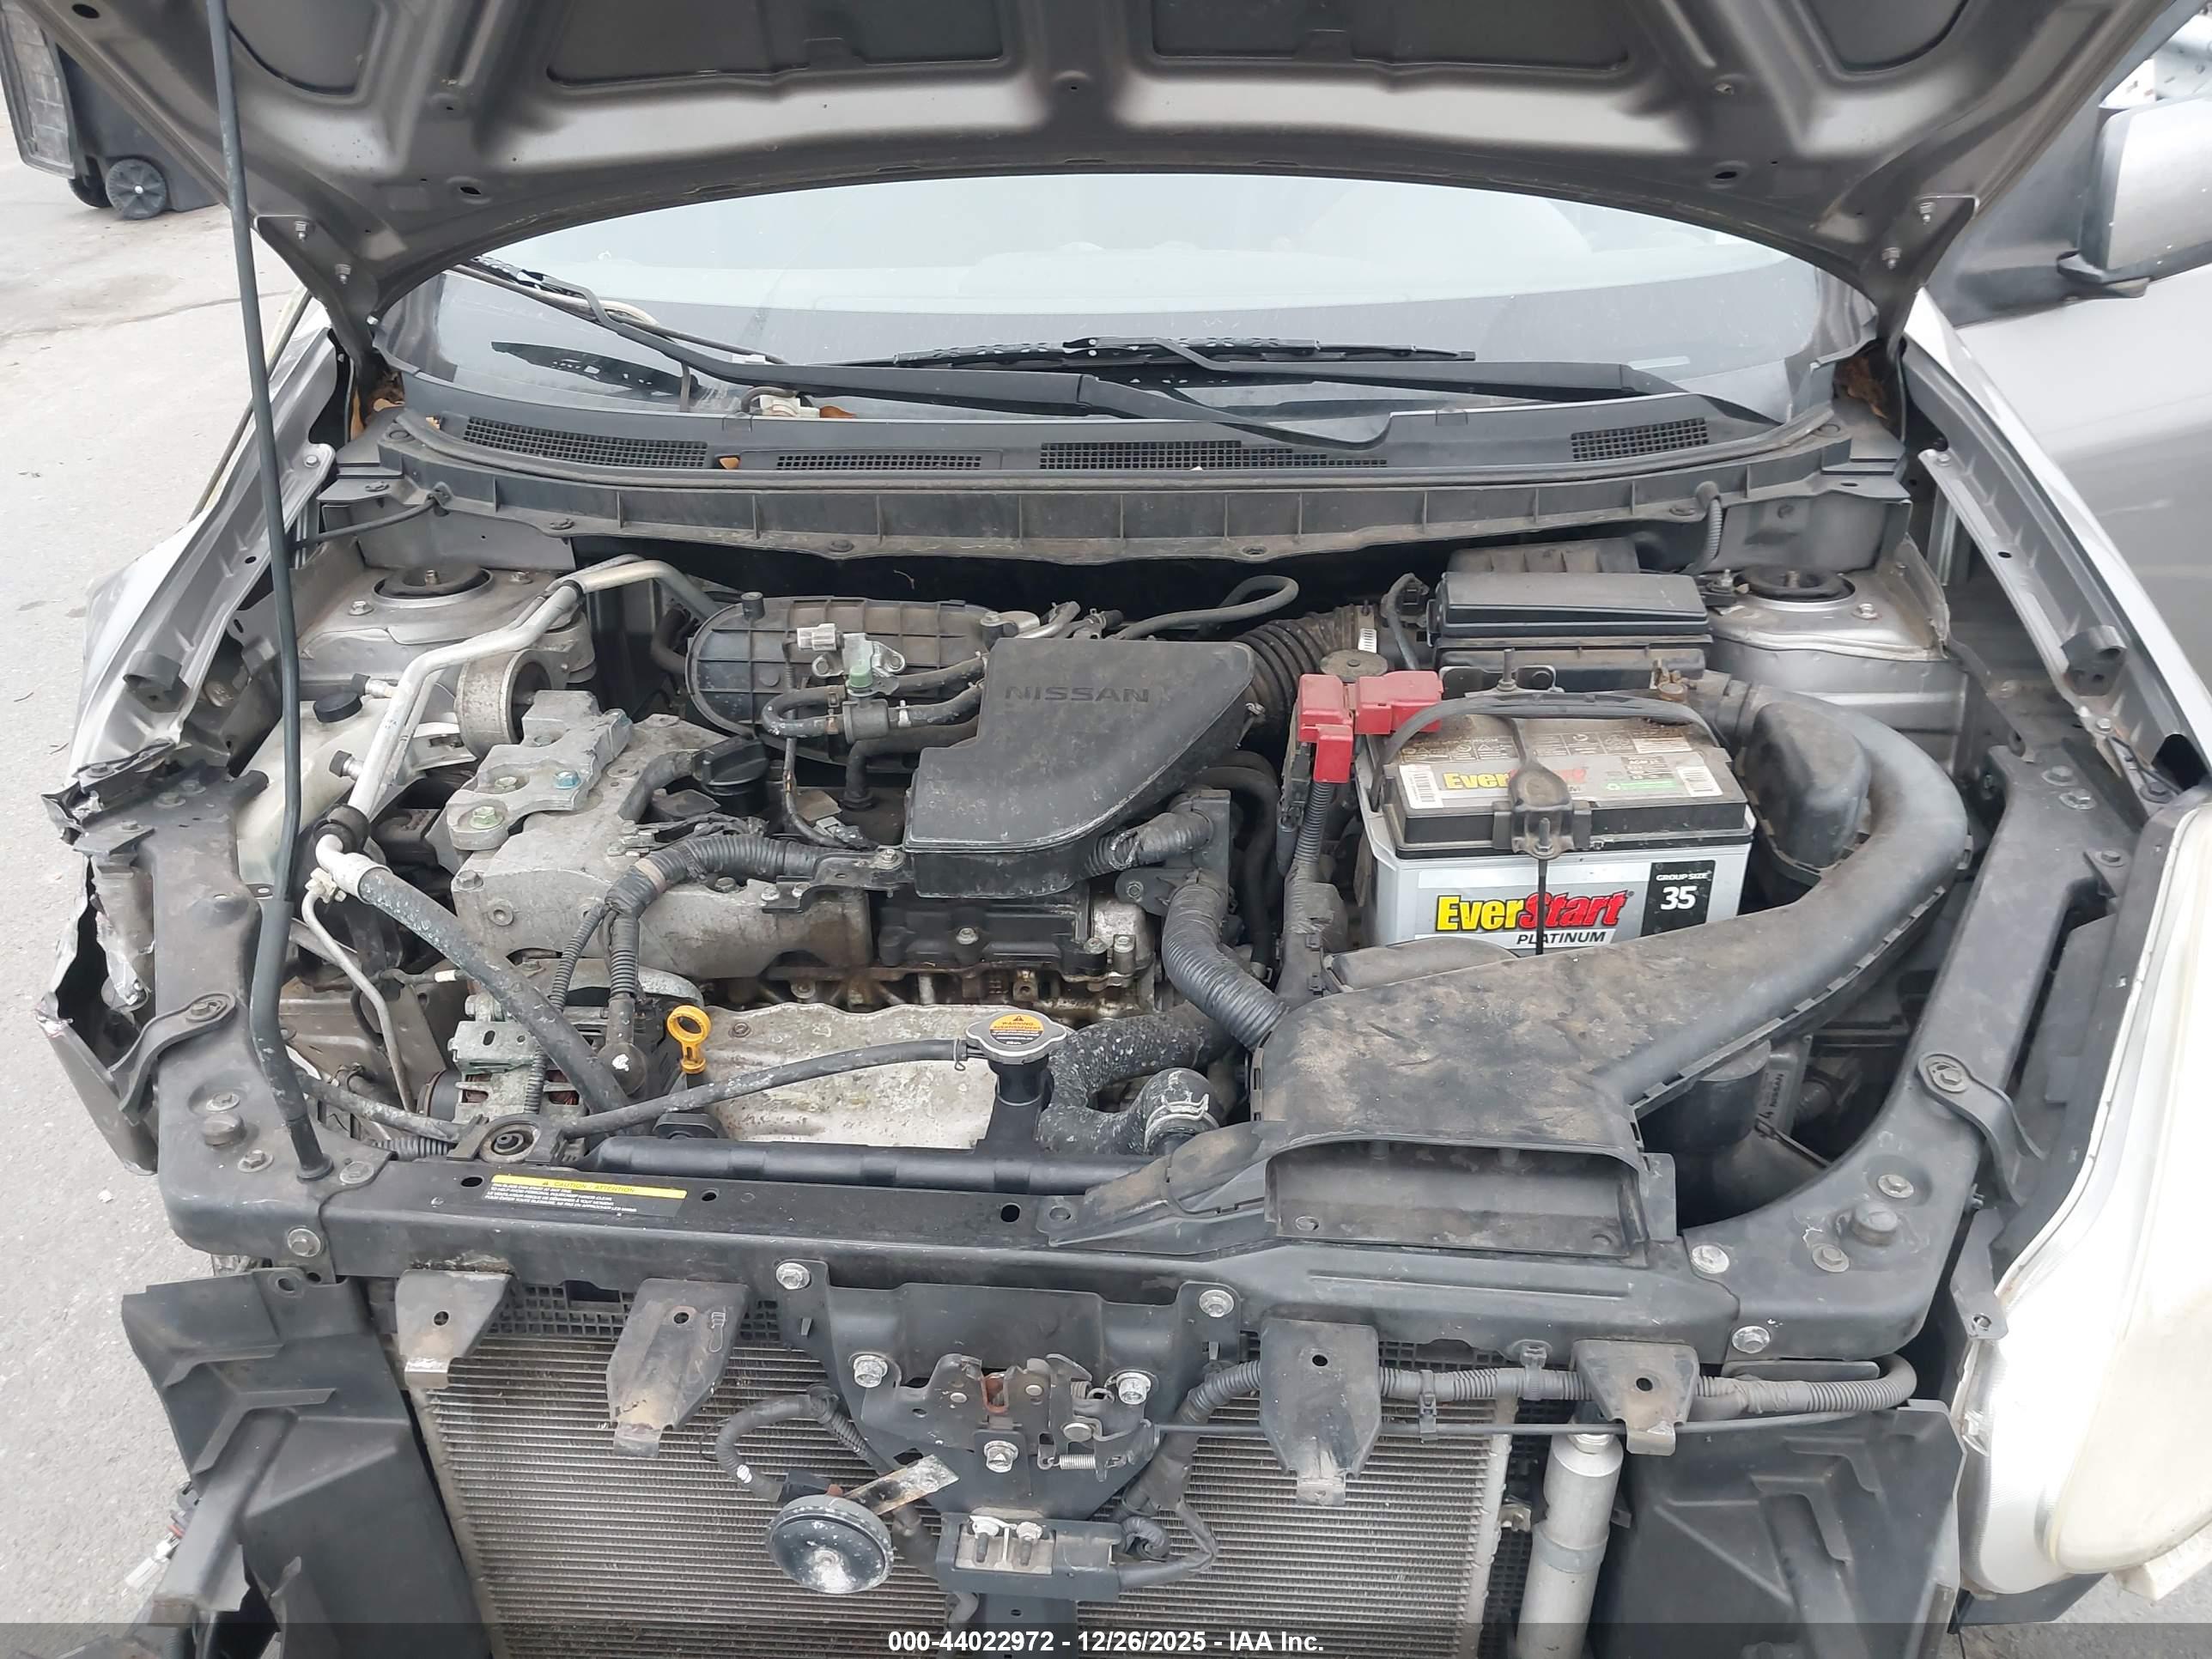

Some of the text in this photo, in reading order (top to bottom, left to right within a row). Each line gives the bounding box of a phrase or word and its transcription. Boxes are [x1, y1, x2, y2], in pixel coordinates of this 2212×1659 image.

[1004, 686, 1149, 702] NISSAN
[1660, 885, 1698, 910] 35
[1436, 890, 1628, 932] EverStart
[1516, 931, 1607, 945] PLATINUM
